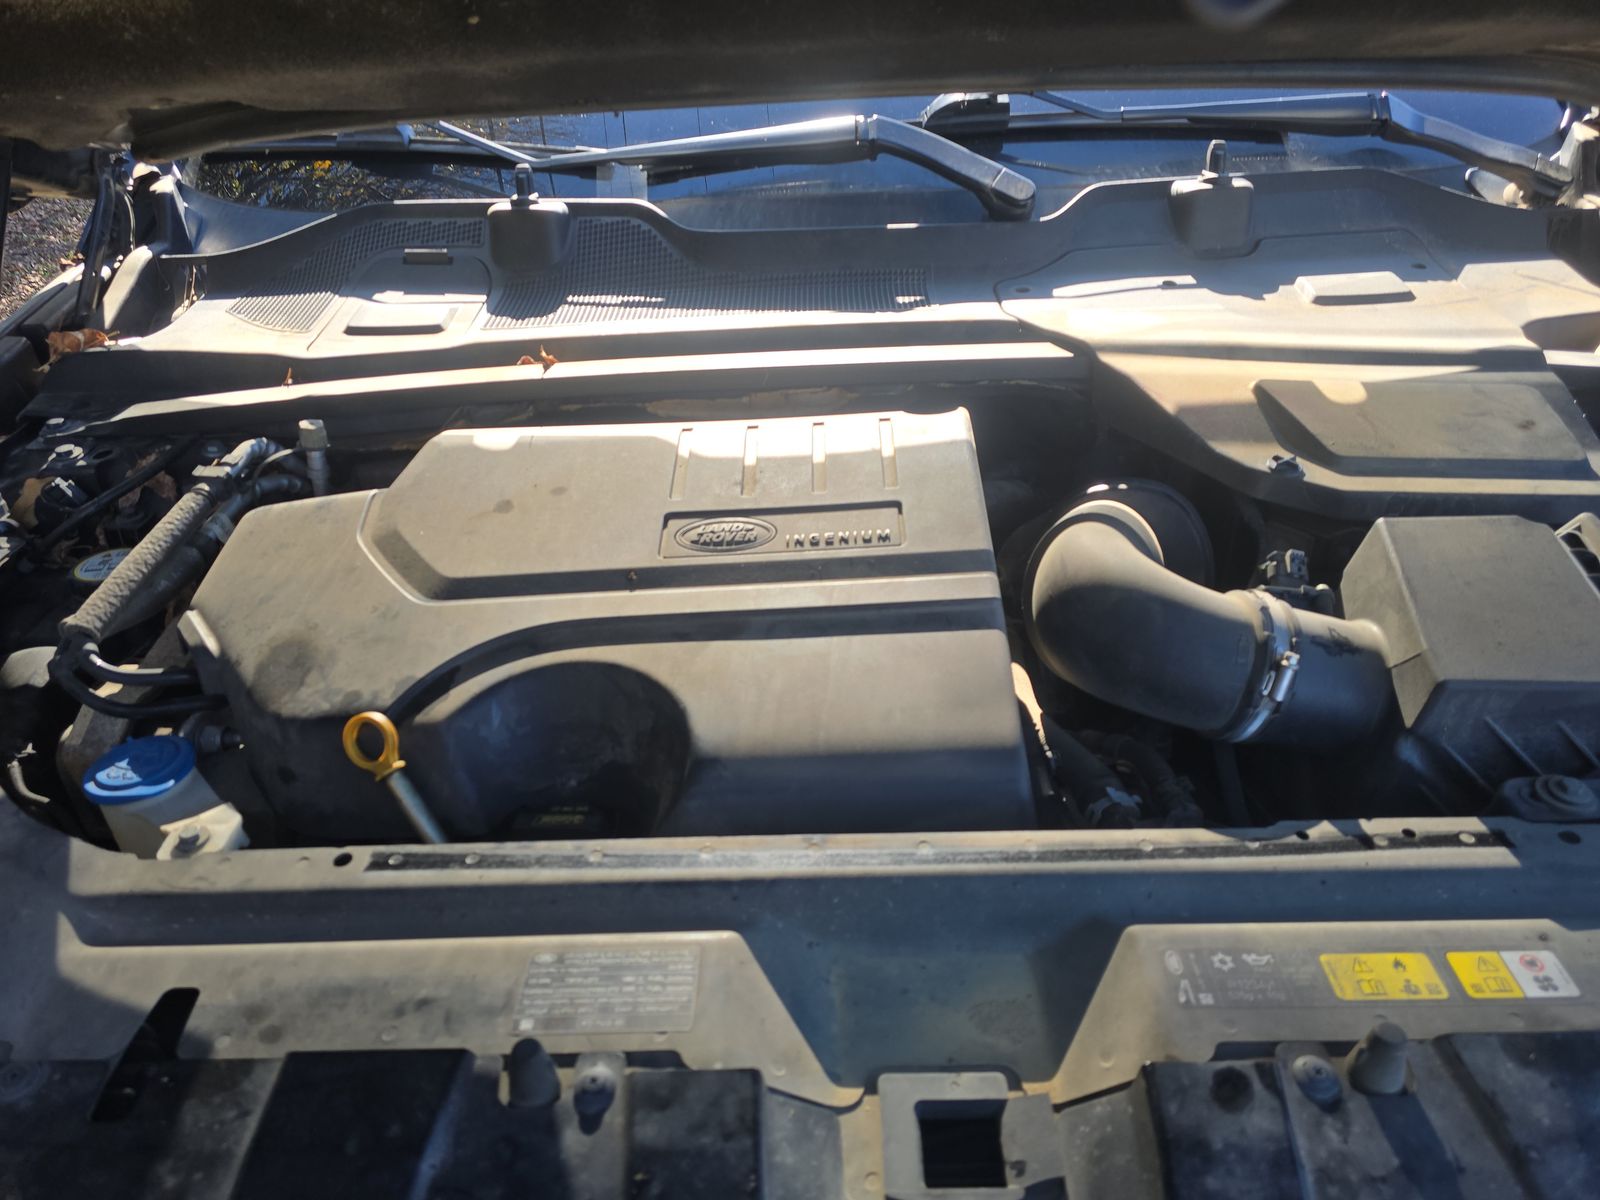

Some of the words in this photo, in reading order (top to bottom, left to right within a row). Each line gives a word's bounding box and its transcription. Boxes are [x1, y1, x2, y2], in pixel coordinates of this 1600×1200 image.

[699, 522, 744, 534] LAND
[700, 531, 757, 544] ROVER
[785, 528, 891, 548] INGENIUM
